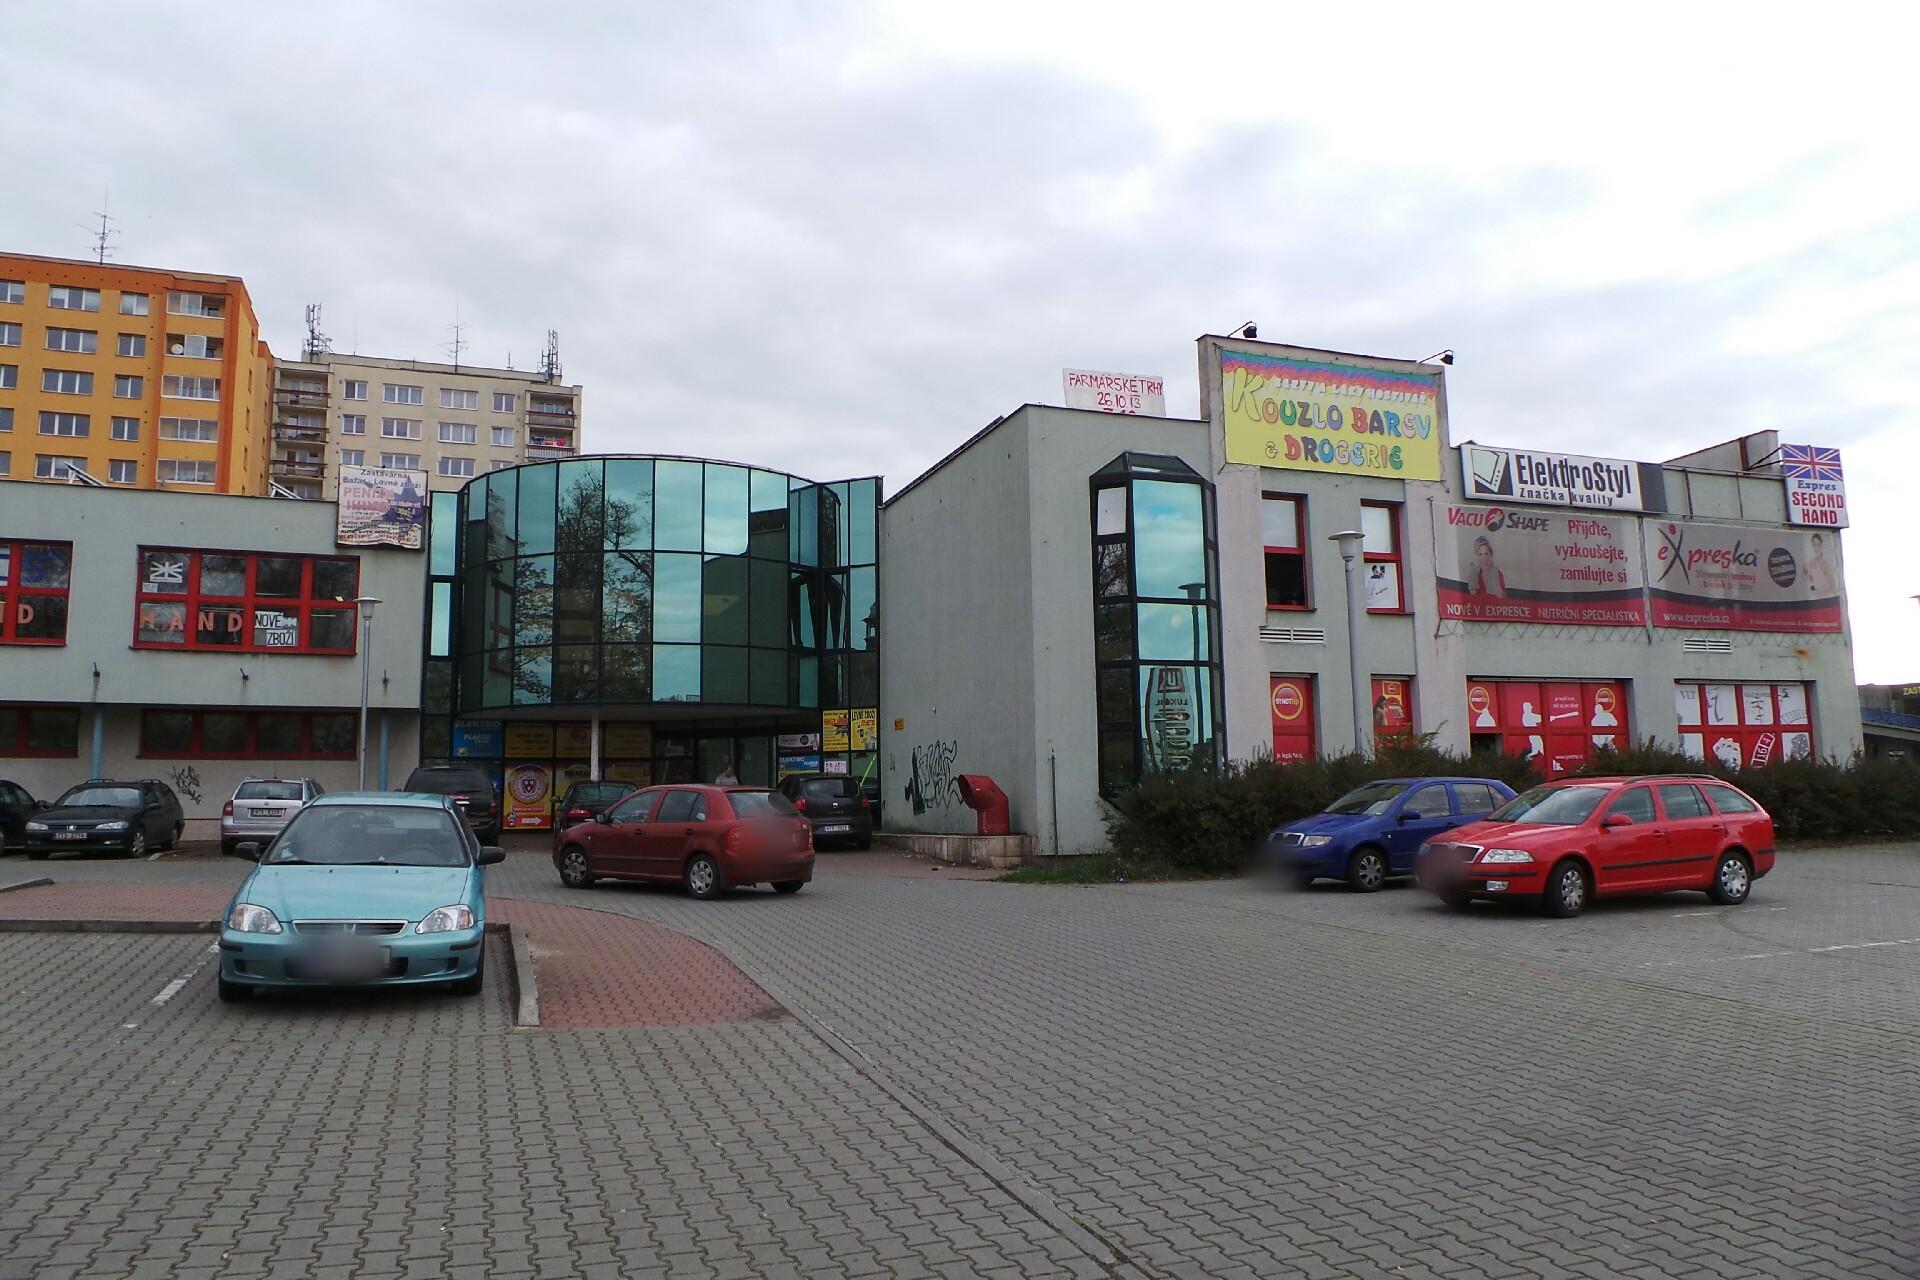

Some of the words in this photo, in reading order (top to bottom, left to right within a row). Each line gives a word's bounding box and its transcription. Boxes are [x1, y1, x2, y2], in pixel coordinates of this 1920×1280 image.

[1138, 379, 1164, 396] TRHY
[1231, 367, 1343, 431] KOUZLO
[1351, 406, 1431, 440] BAREV
[1284, 434, 1404, 470] DROGERIE
[1515, 454, 1632, 499] ElektroStyl
[1797, 480, 1837, 491] Expres
[1519, 487, 1565, 501] Značka
[1571, 492, 1613, 507] kvality
[1791, 491, 1844, 509] SECOND
[1448, 507, 1484, 527] VACU
[1506, 512, 1550, 532] SHAPE
[1802, 508, 1838, 525] HAND
[1568, 519, 1612, 539] Přijďte,
[1554, 542, 1628, 564] vyzkoušejte,
[1560, 566, 1613, 585] zamilujte
[1617, 569, 1627, 583] si
[139, 604, 243, 633] HAND
[255, 611, 283, 628] NOVÉ
[1474, 606, 1481, 616] V
[1582, 609, 1640, 622] SPECIALISTKA
